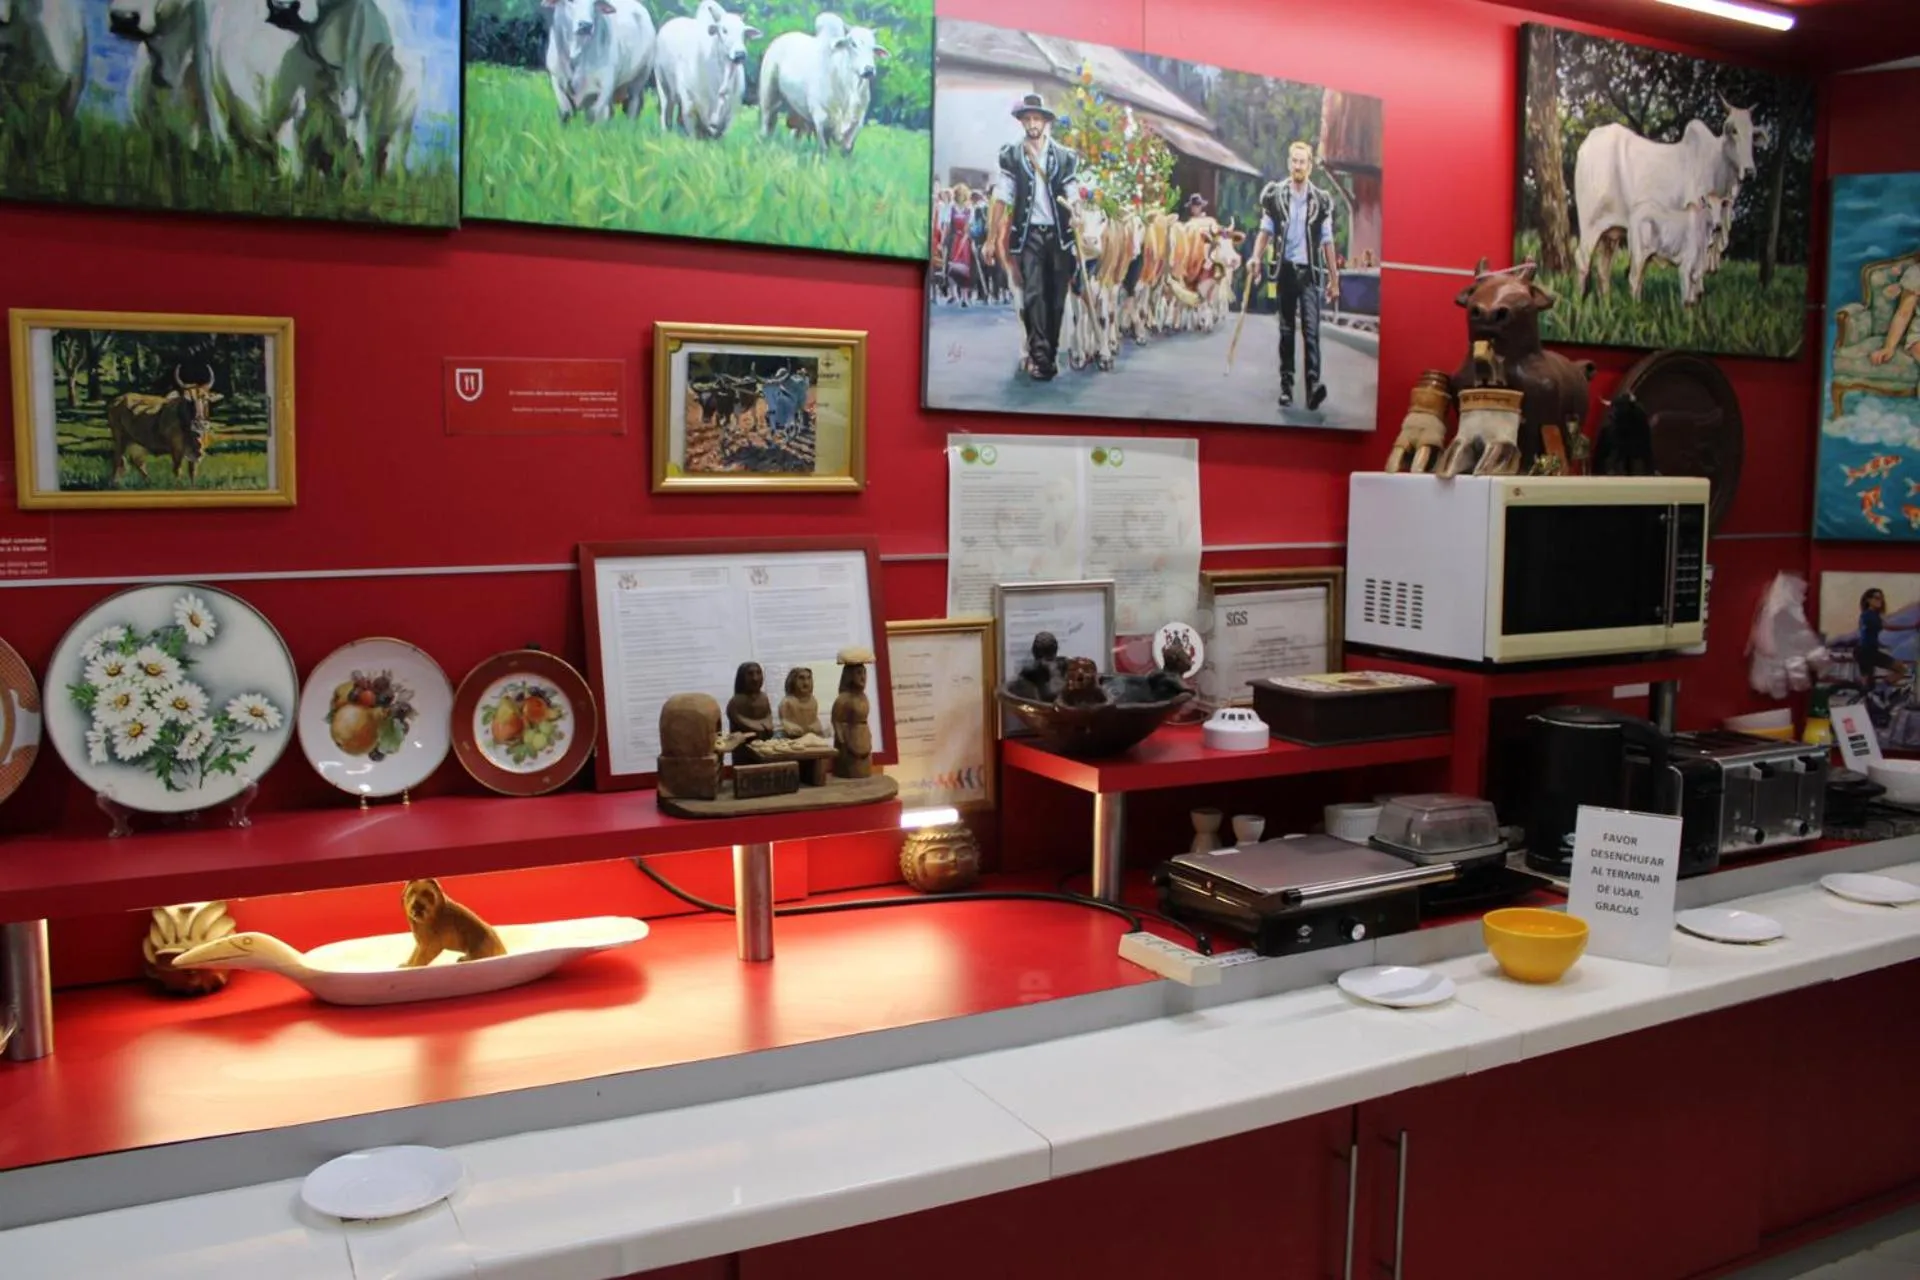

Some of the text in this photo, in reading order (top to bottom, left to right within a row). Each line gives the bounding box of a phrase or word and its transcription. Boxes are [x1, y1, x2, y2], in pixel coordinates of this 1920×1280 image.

[1226, 610, 1248, 627] SGS
[1603, 832, 1638, 846] FAVOR
[1591, 848, 1665, 866] DESENCHUFAR
[1591, 866, 1660, 884] AL TERMINAR
[1597, 883, 1644, 899] DE USAR.
[1595, 900, 1639, 916] GRACIAS
